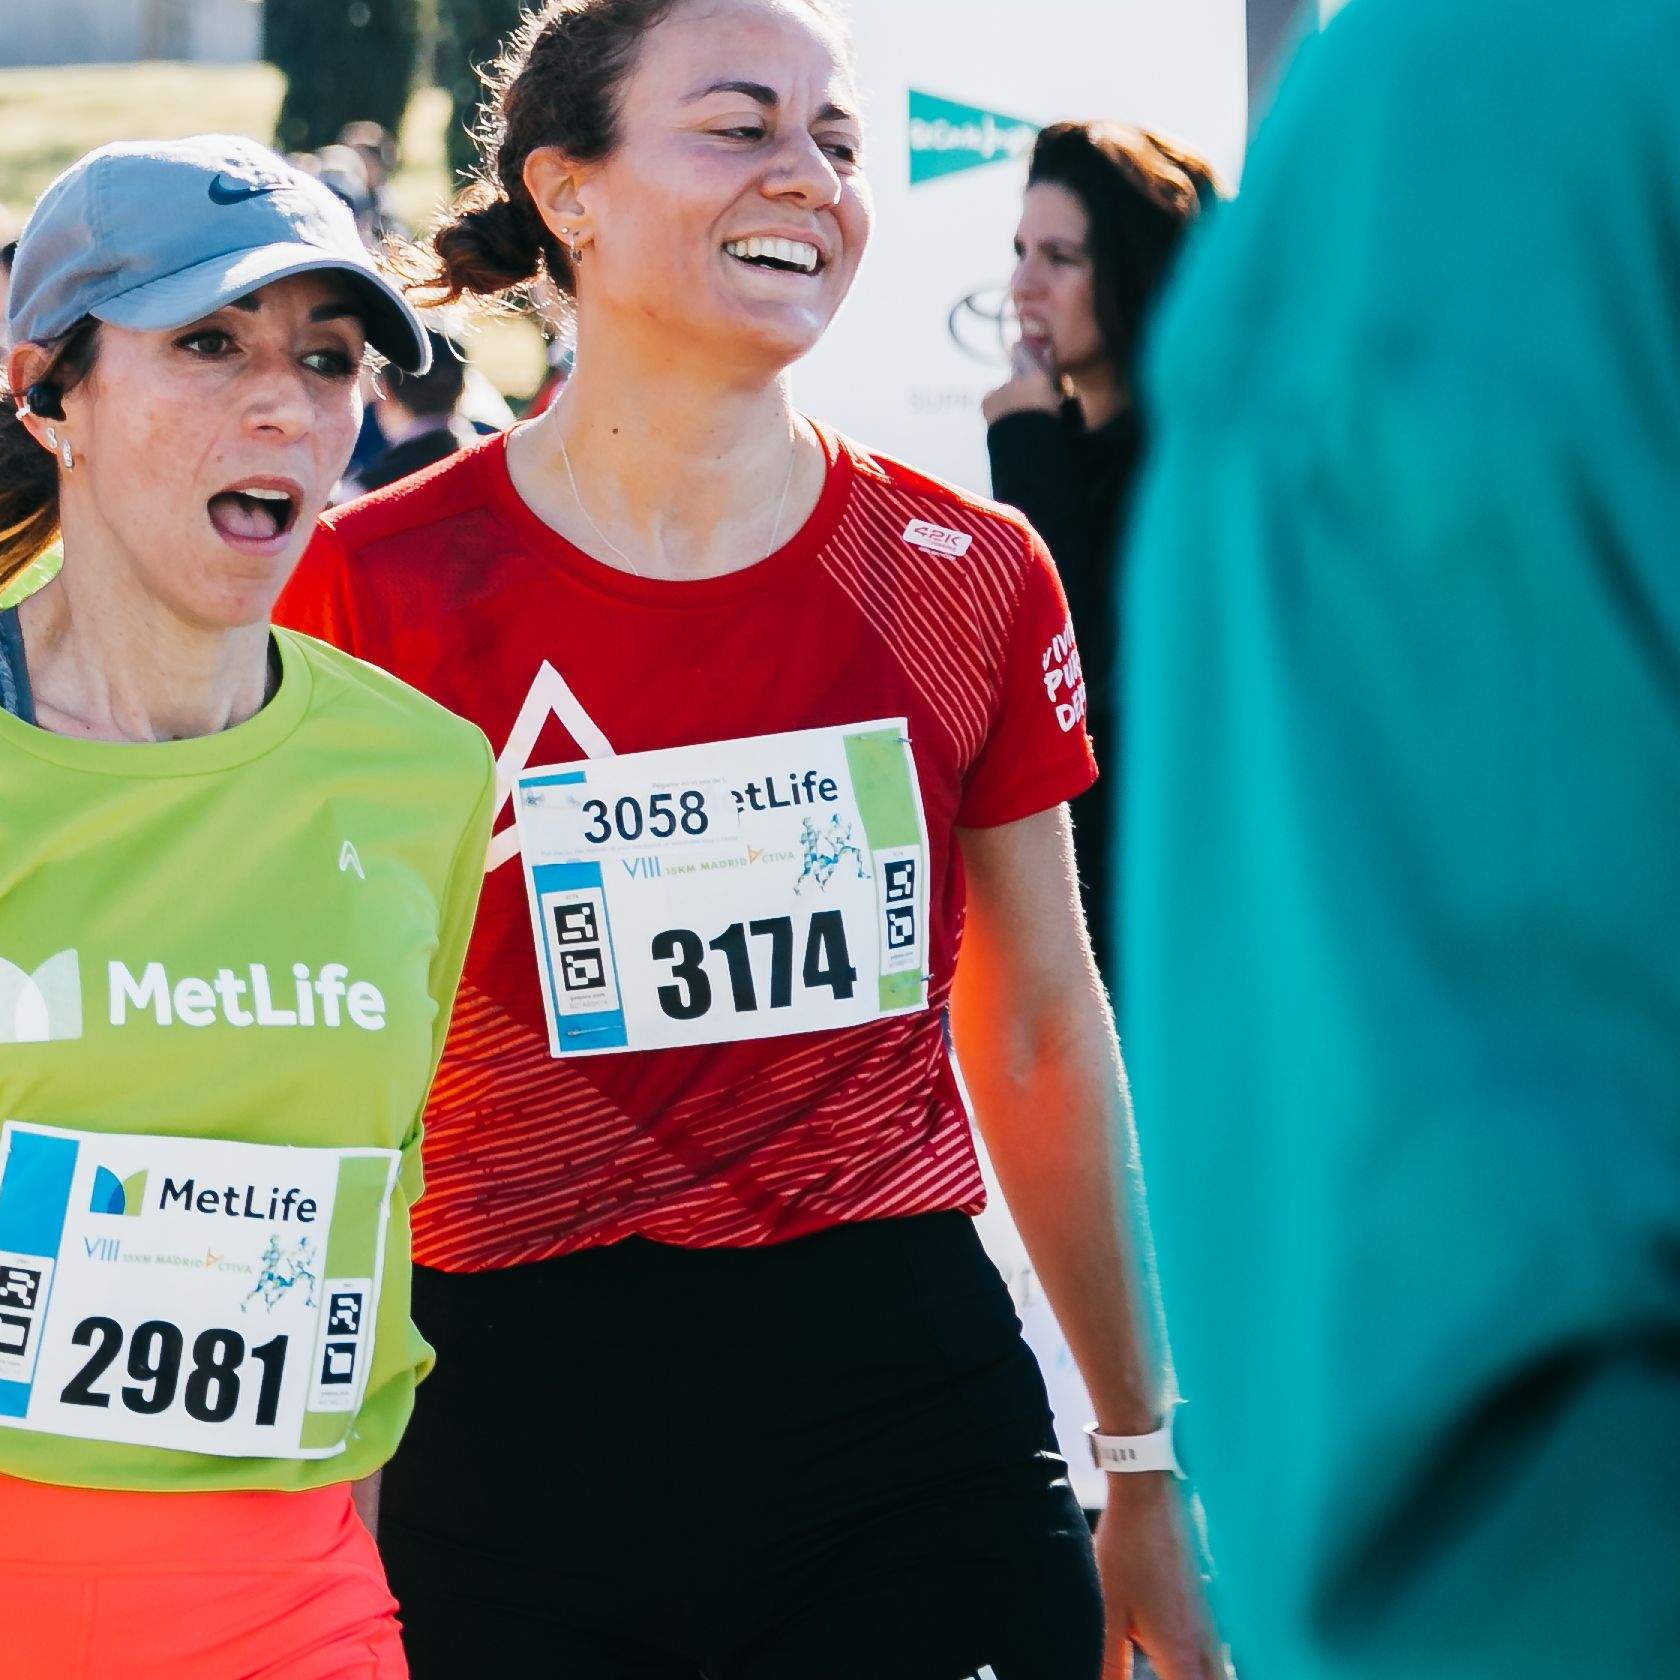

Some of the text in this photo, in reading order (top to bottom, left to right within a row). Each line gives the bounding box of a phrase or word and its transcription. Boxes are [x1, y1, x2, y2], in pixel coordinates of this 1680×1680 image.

[581, 789, 710, 845] 3058
[730, 769, 839, 815] etLife
[106, 960, 388, 1031] MetLife
[650, 908, 858, 1021] 3174
[158, 1177, 318, 1223] MetLife
[59, 1315, 290, 1427] 2981
